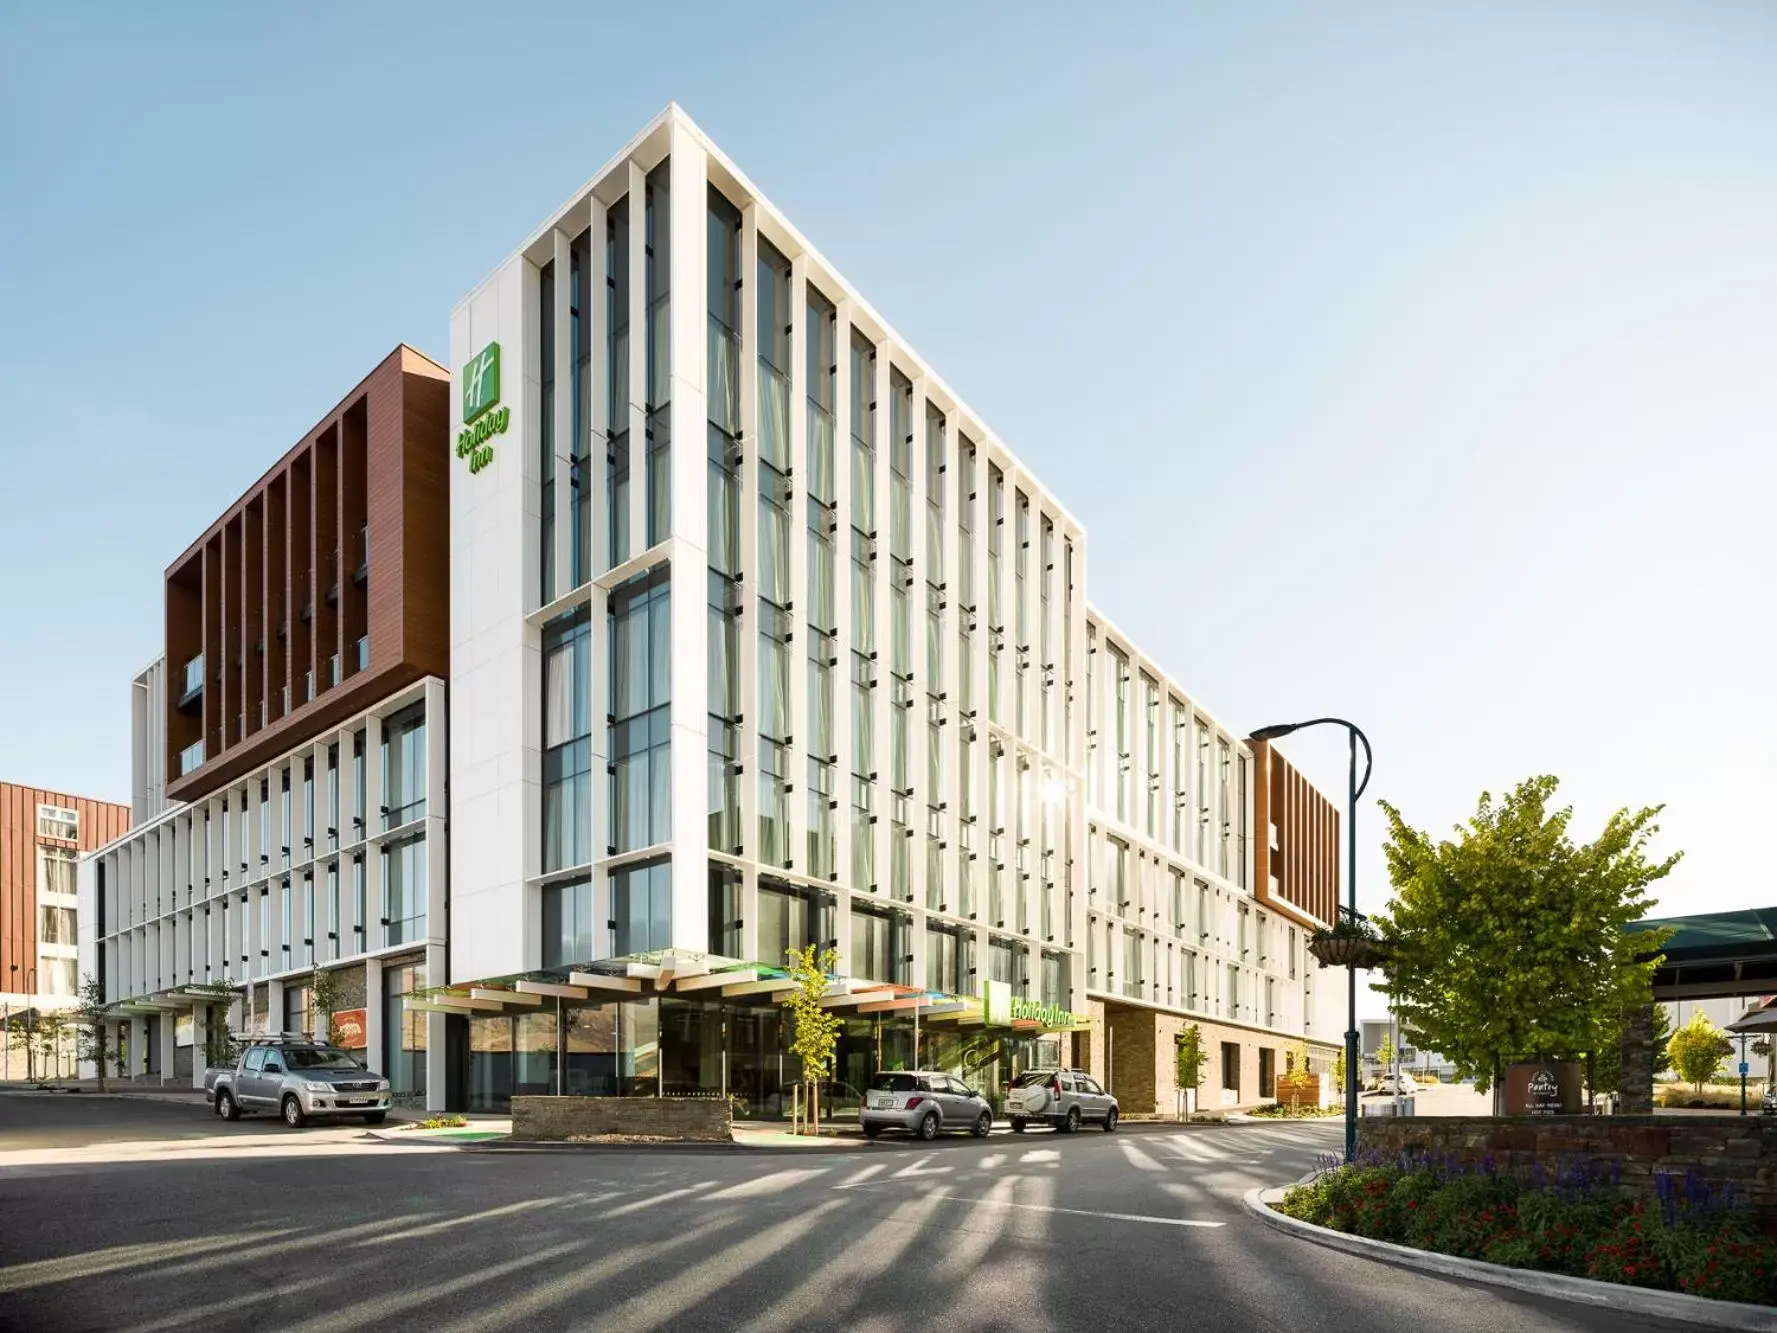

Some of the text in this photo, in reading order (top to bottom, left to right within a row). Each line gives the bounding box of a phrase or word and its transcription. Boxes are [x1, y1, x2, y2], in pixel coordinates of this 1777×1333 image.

[456, 406, 510, 459] Holiday
[469, 445, 493, 474] Inn
[1010, 998, 1054, 1028] Holiday
